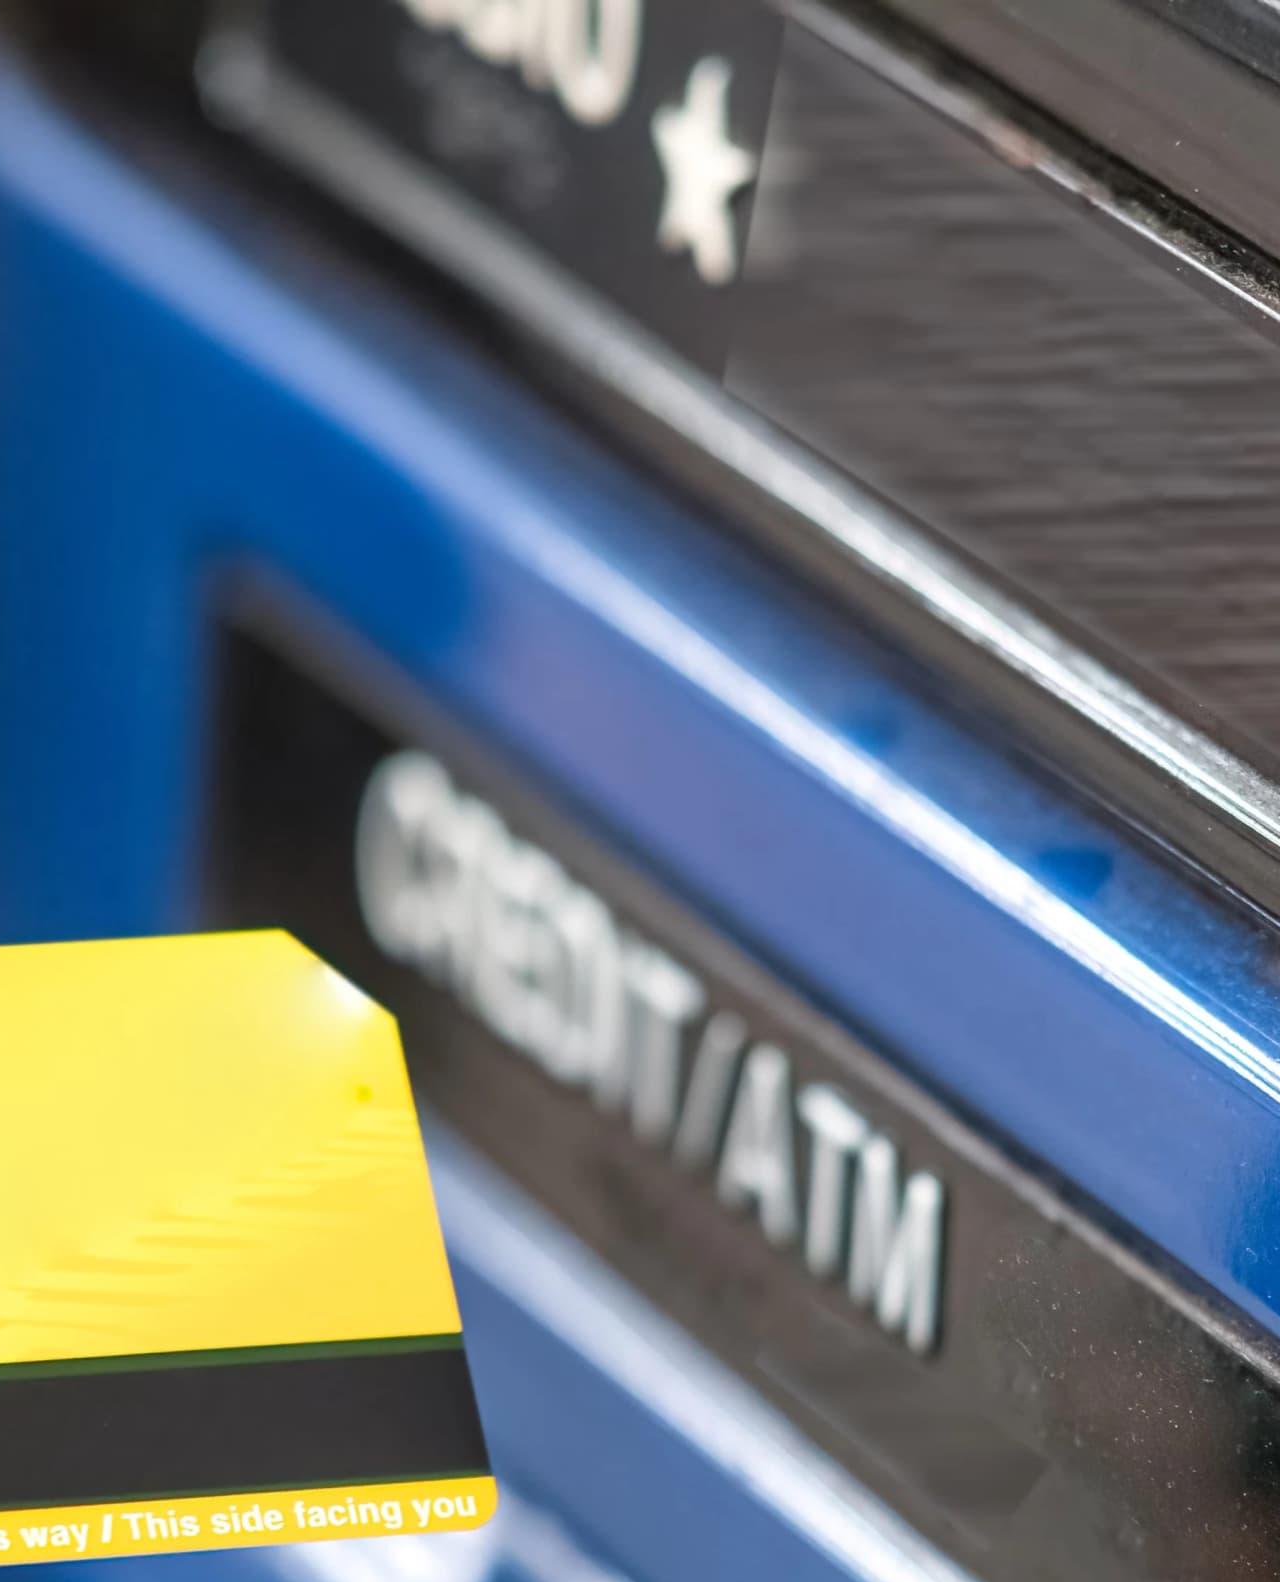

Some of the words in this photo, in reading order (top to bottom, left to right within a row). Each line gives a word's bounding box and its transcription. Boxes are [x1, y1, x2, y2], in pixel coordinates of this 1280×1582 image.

[19, 1523, 89, 1553] way
[101, 1513, 113, 1543] /
[121, 1509, 200, 1540] This
[210, 1503, 284, 1535] side
[293, 1497, 403, 1530] facing
[411, 1495, 477, 1528] you
